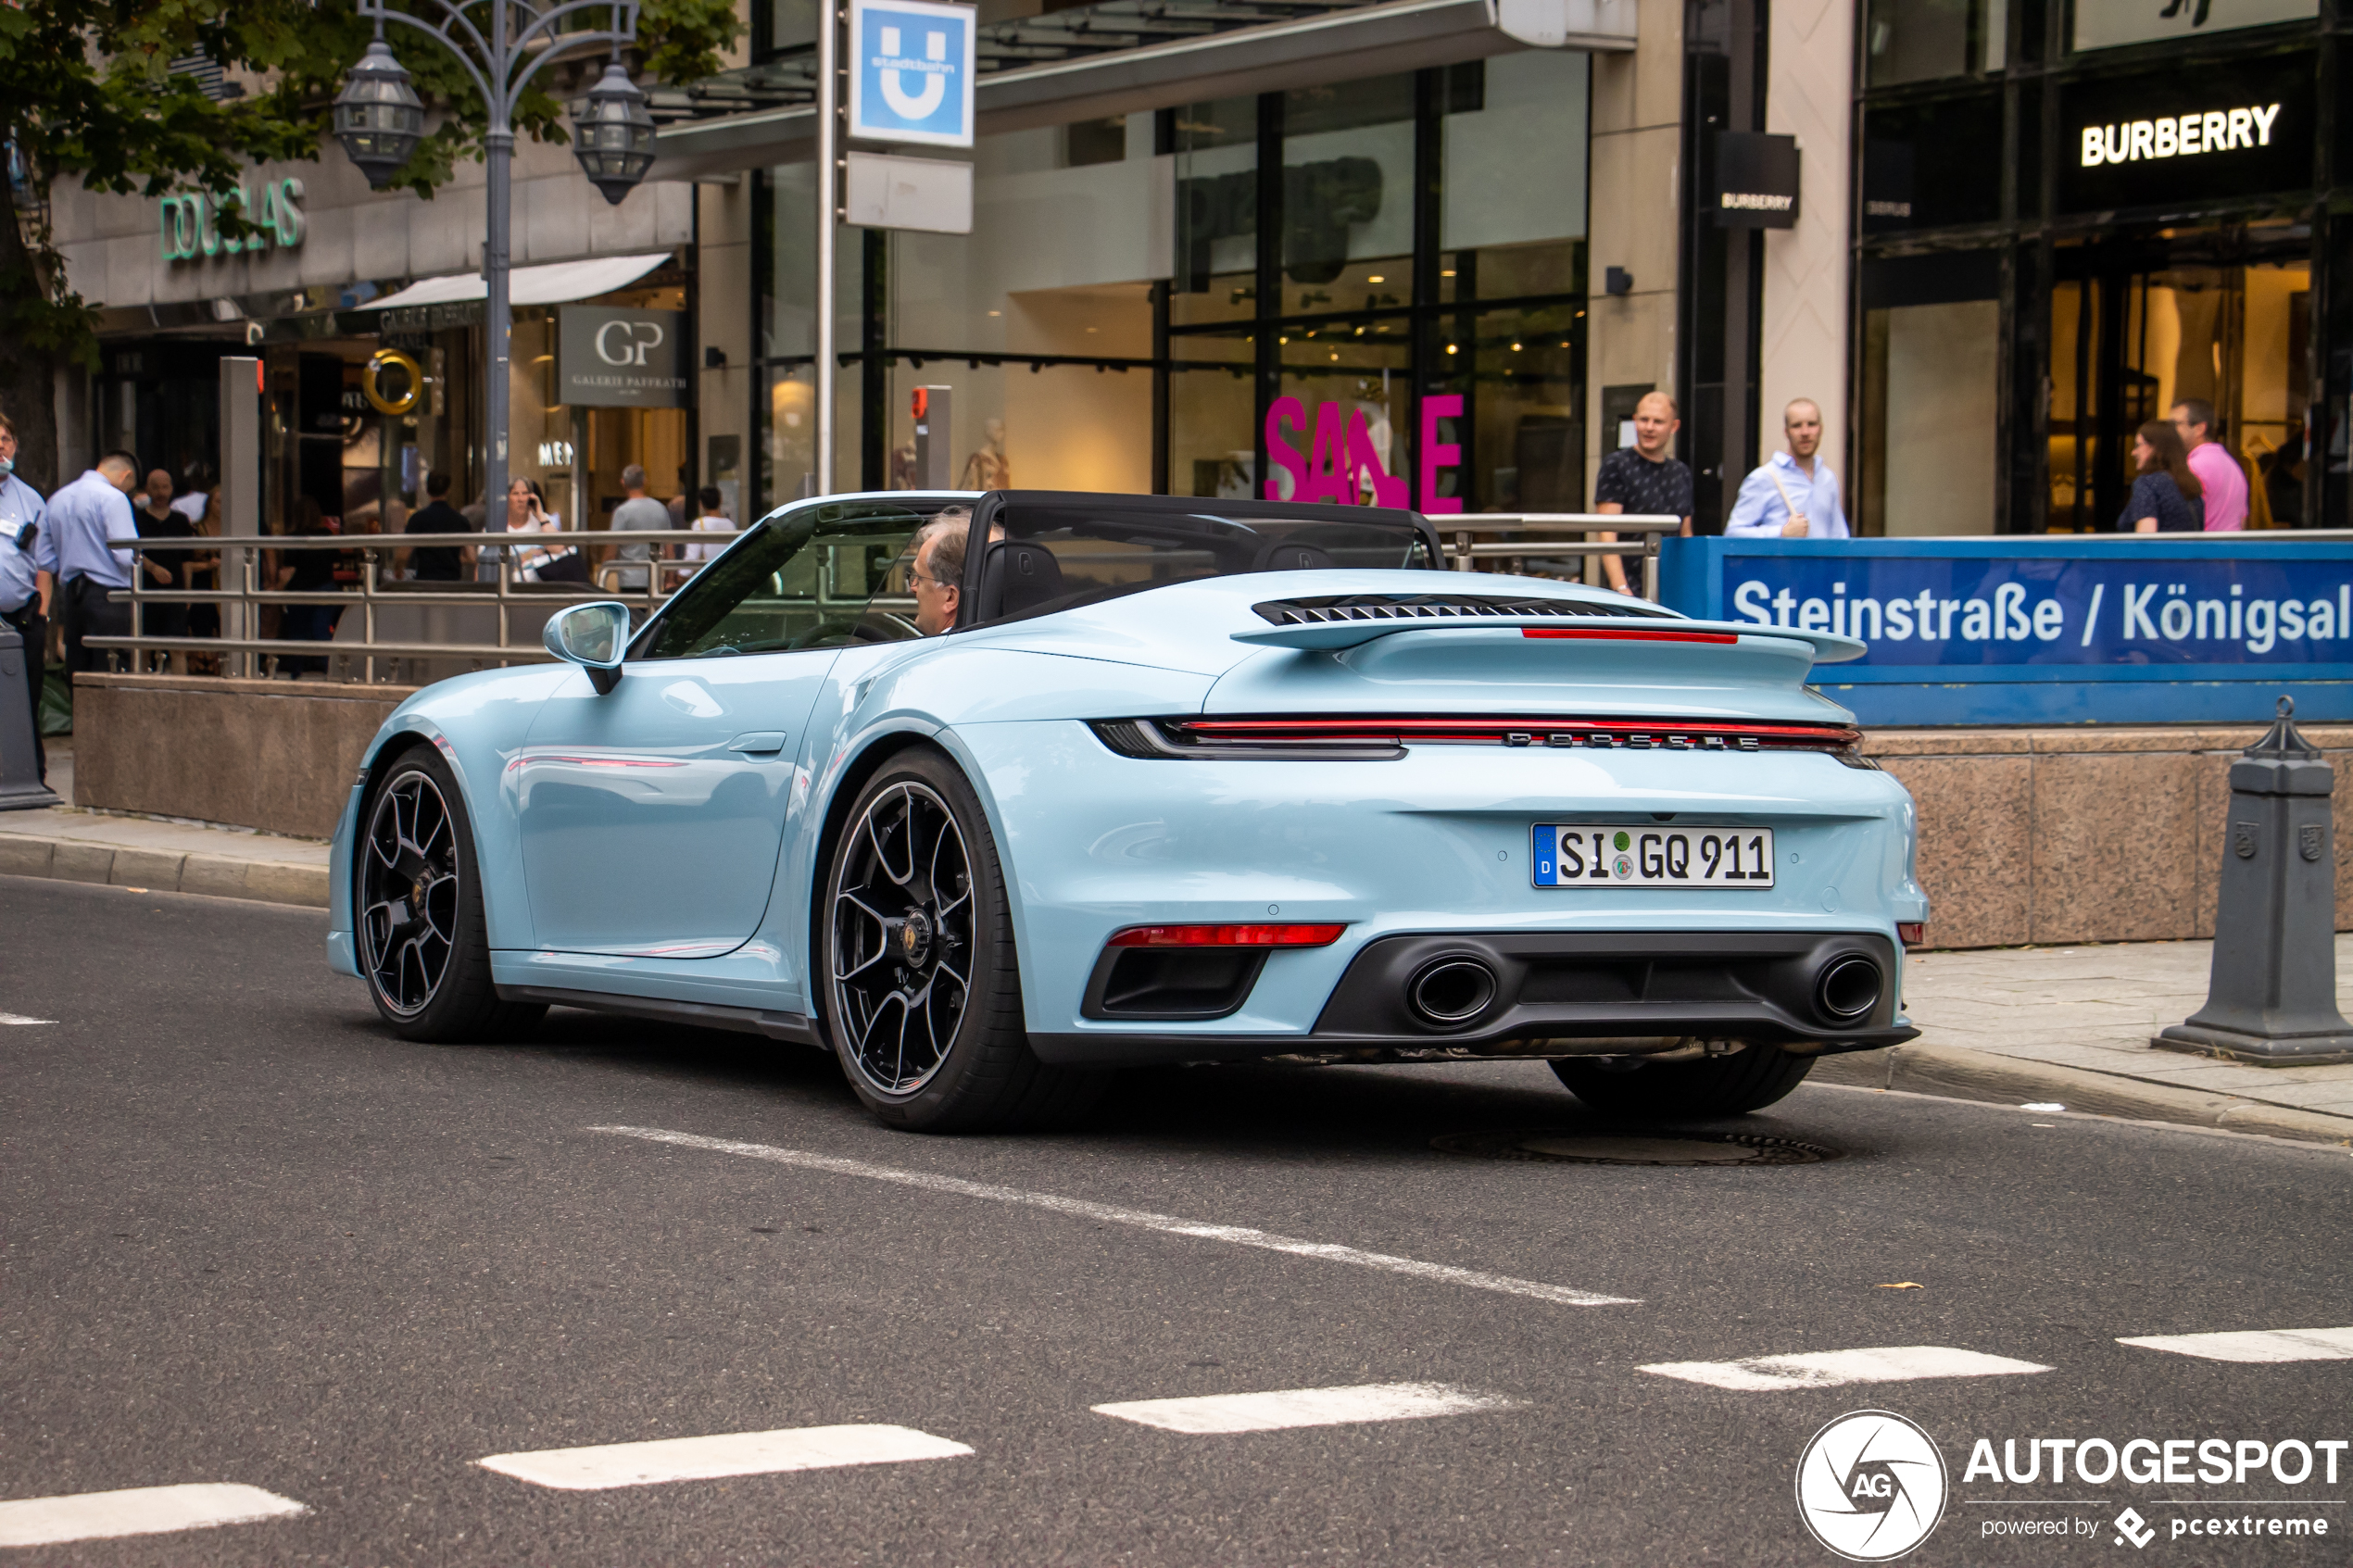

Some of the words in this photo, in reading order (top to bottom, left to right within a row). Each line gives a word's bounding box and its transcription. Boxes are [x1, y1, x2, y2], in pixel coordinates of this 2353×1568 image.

[872, 56, 955, 73] stadtbahn
[2081, 104, 2281, 167] BURBERRY
[1721, 192, 1793, 211] BURBERRY
[596, 320, 663, 366] GP
[572, 375, 623, 386] GALERIE
[1733, 580, 2063, 641] Steinstraße
[2082, 583, 2104, 646] /
[1541, 860, 1551, 874] D
[1560, 832, 1609, 879] SI
[1640, 834, 1689, 879] GQ
[1700, 834, 1769, 880] 911
